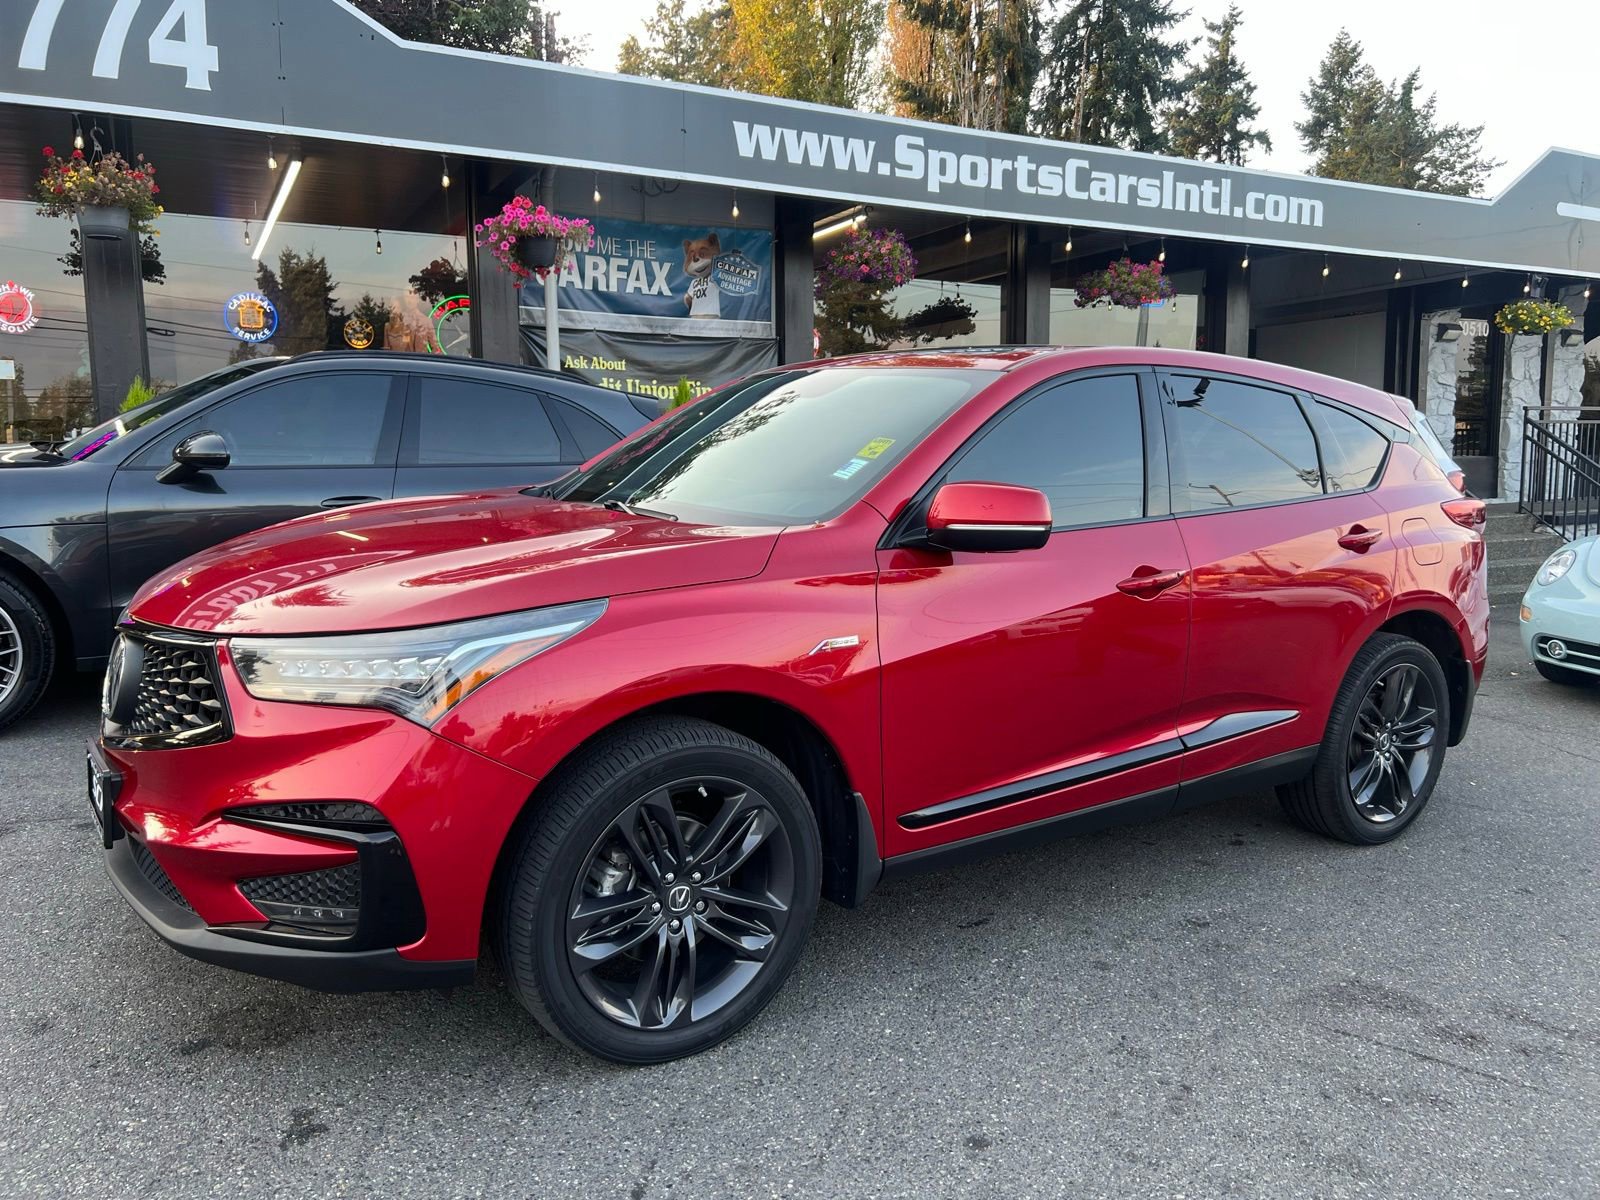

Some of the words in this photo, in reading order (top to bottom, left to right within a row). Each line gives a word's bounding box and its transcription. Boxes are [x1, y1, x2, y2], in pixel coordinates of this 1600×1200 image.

[732, 120, 1324, 228] www.SportsCarsIntl.com
[596, 236, 622, 256] ME
[625, 239, 657, 260] THE
[716, 260, 758, 280] CARFAX
[717, 271, 752, 287] ADVANTAGE
[0, 283, 35, 302] HAWK
[692, 287, 708, 299] FOX
[720, 280, 745, 293] DEALER
[228, 292, 274, 313] CADILLAC
[0, 315, 40, 333] SOLINE
[1459, 320, 1490, 337] 0510
[233, 326, 272, 341] SERVICE
[564, 355, 588, 369] Ask
[590, 356, 627, 371] About
[625, 378, 678, 400] Union
